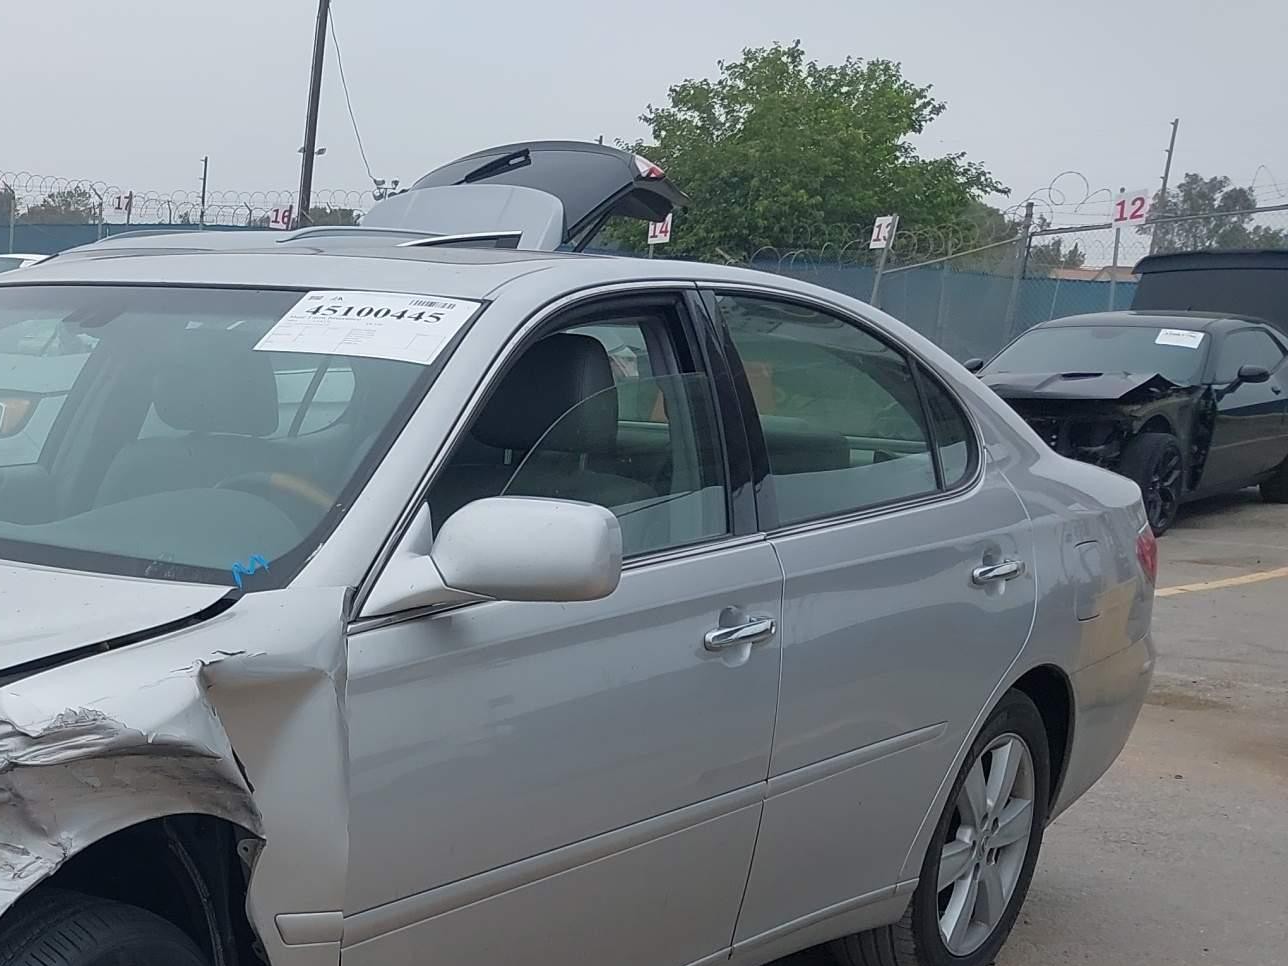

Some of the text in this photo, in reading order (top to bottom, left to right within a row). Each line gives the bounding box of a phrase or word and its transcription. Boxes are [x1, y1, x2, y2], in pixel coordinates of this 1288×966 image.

[1114, 196, 1146, 223] 12
[649, 222, 669, 239] 14
[305, 304, 444, 324] 45100445
